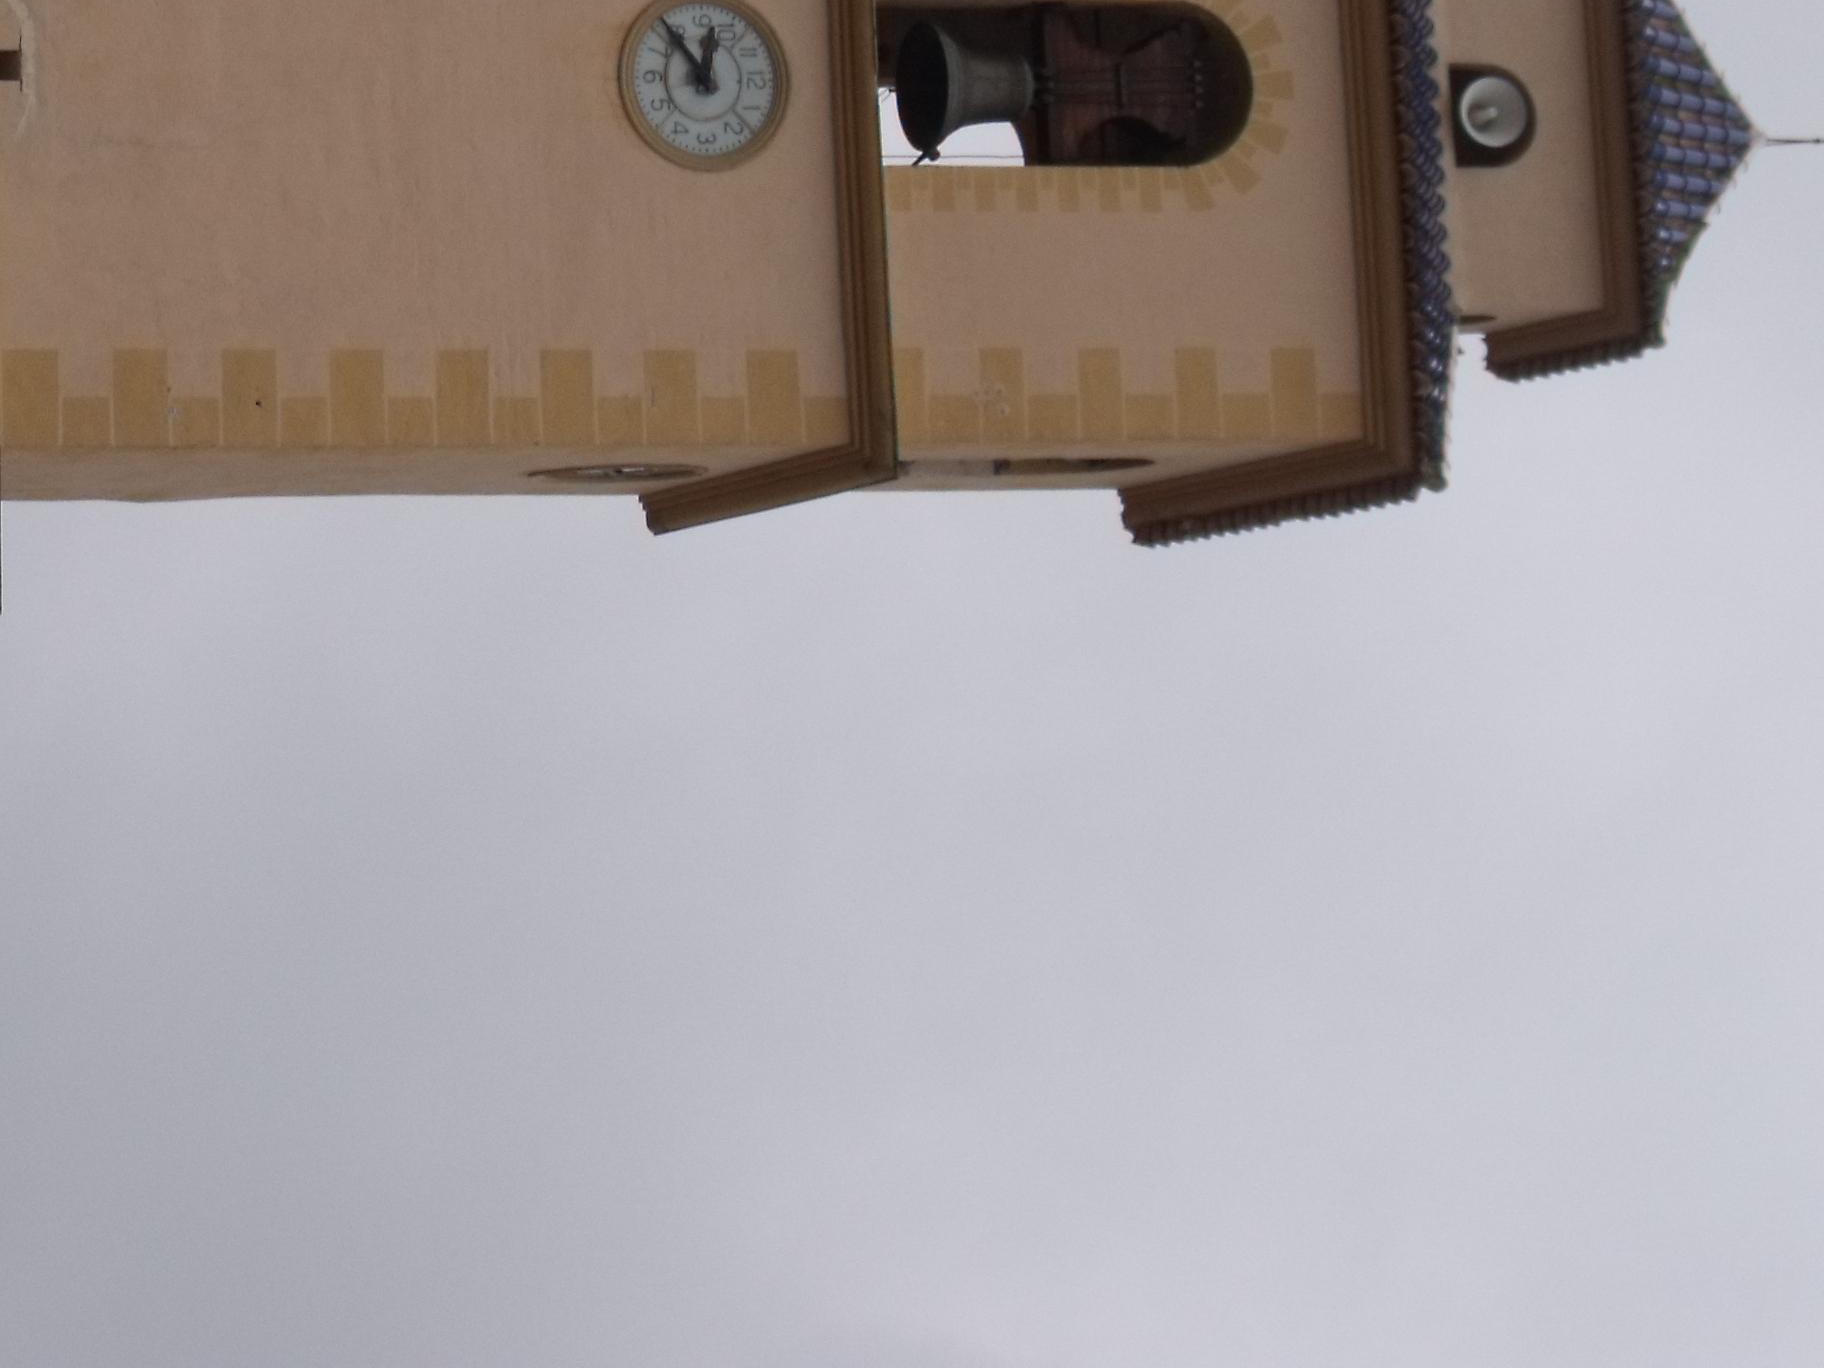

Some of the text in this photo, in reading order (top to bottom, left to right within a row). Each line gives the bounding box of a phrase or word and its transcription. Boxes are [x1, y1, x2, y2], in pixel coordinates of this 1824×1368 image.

[692, 14, 713, 27] 9
[717, 23, 737, 42] 10
[647, 47, 669, 59] 7
[739, 47, 758, 58] 11
[643, 70, 663, 84] 6
[746, 71, 767, 90] 12
[651, 98, 672, 111] 5
[671, 121, 689, 135] 4
[723, 122, 744, 136] 2
[696, 132, 716, 145] 3
